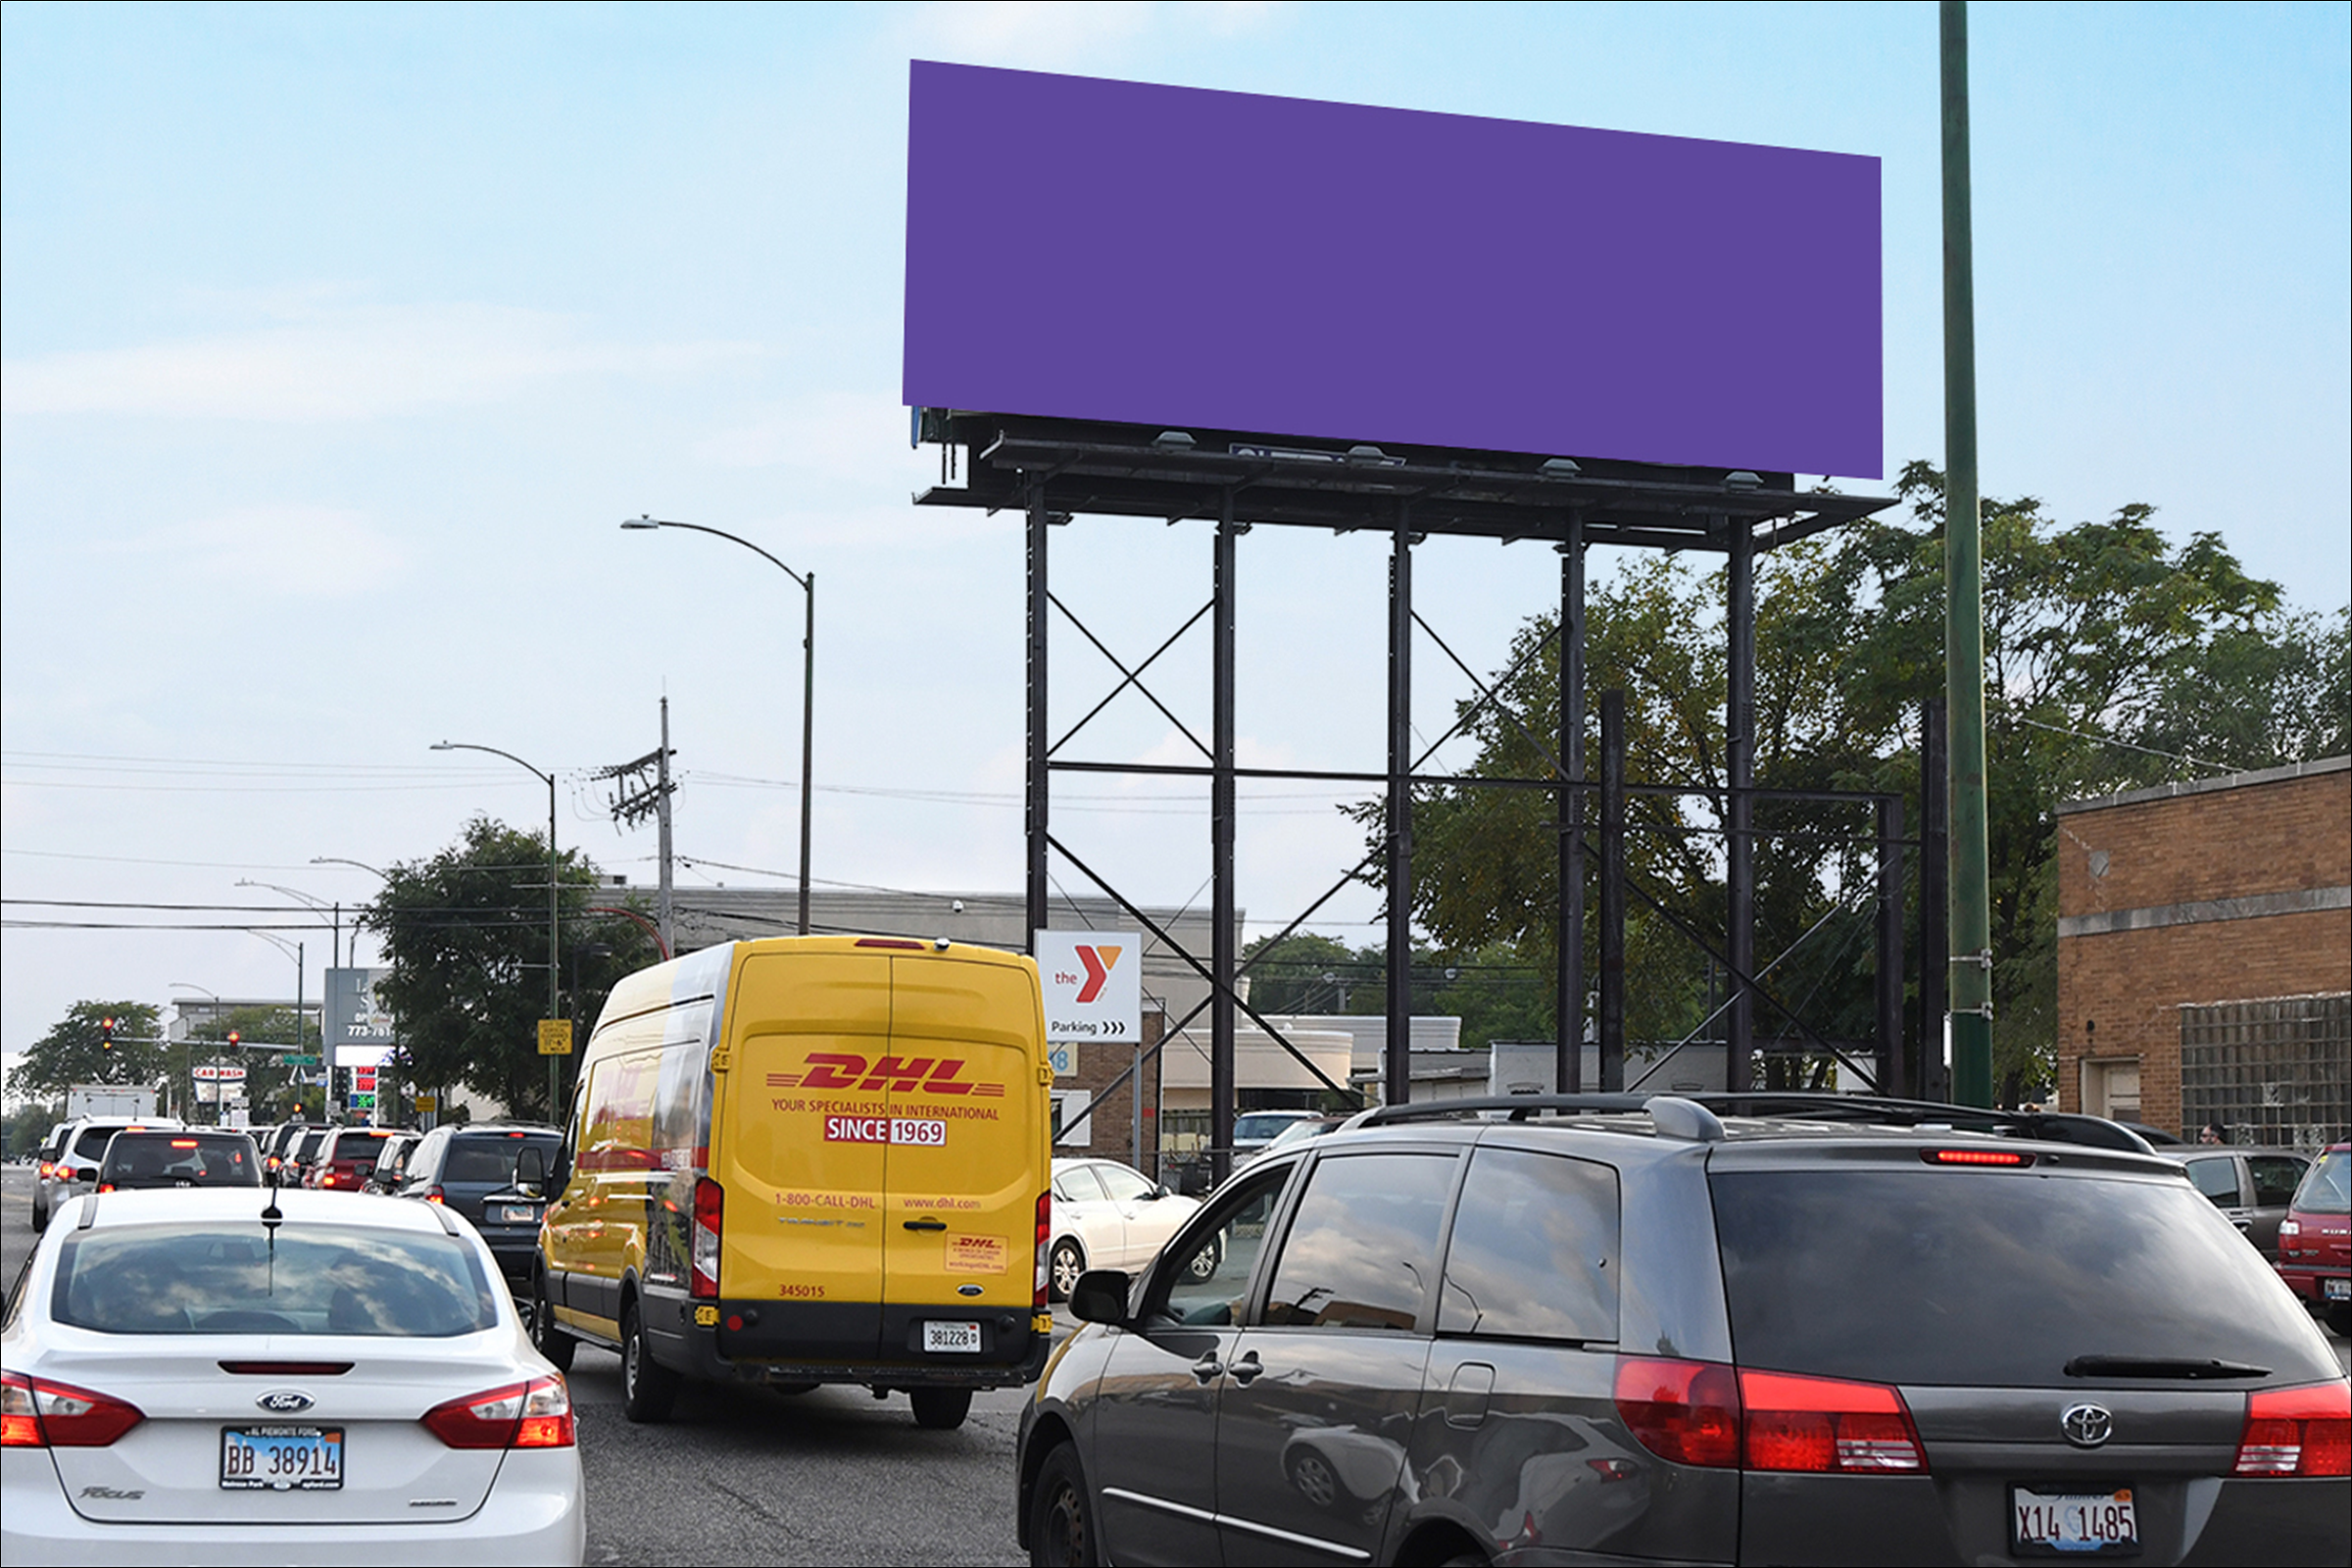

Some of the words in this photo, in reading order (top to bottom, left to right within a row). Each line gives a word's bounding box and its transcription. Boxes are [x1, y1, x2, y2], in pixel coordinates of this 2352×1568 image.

[1054, 971, 1077, 985] the
[1052, 1021, 1097, 1036] Parking
[194, 1068, 216, 1077] CAR
[219, 1068, 244, 1077] WASH
[799, 1053, 974, 1095] DHL
[771, 1099, 806, 1112] YOUR
[808, 1100, 886, 1115] SPECIALISTS
[890, 1104, 903, 1116] IN
[906, 1105, 1000, 1121] INTERNATIONAL
[827, 1117, 887, 1141] SINCE
[894, 1121, 944, 1143] 1969
[775, 1193, 875, 1209] 1-800-CALL-DHL
[904, 1197, 980, 1209] www.dhl.com
[959, 1237, 995, 1249] DHL
[779, 1283, 826, 1298] 345015
[930, 1329, 969, 1346] 381228
[269, 1394, 302, 1408] Ford
[227, 1445, 255, 1475] BB
[268, 1445, 337, 1475] 38914
[2019, 1505, 2060, 1541] X14
[2079, 1505, 2133, 1541] 1485
